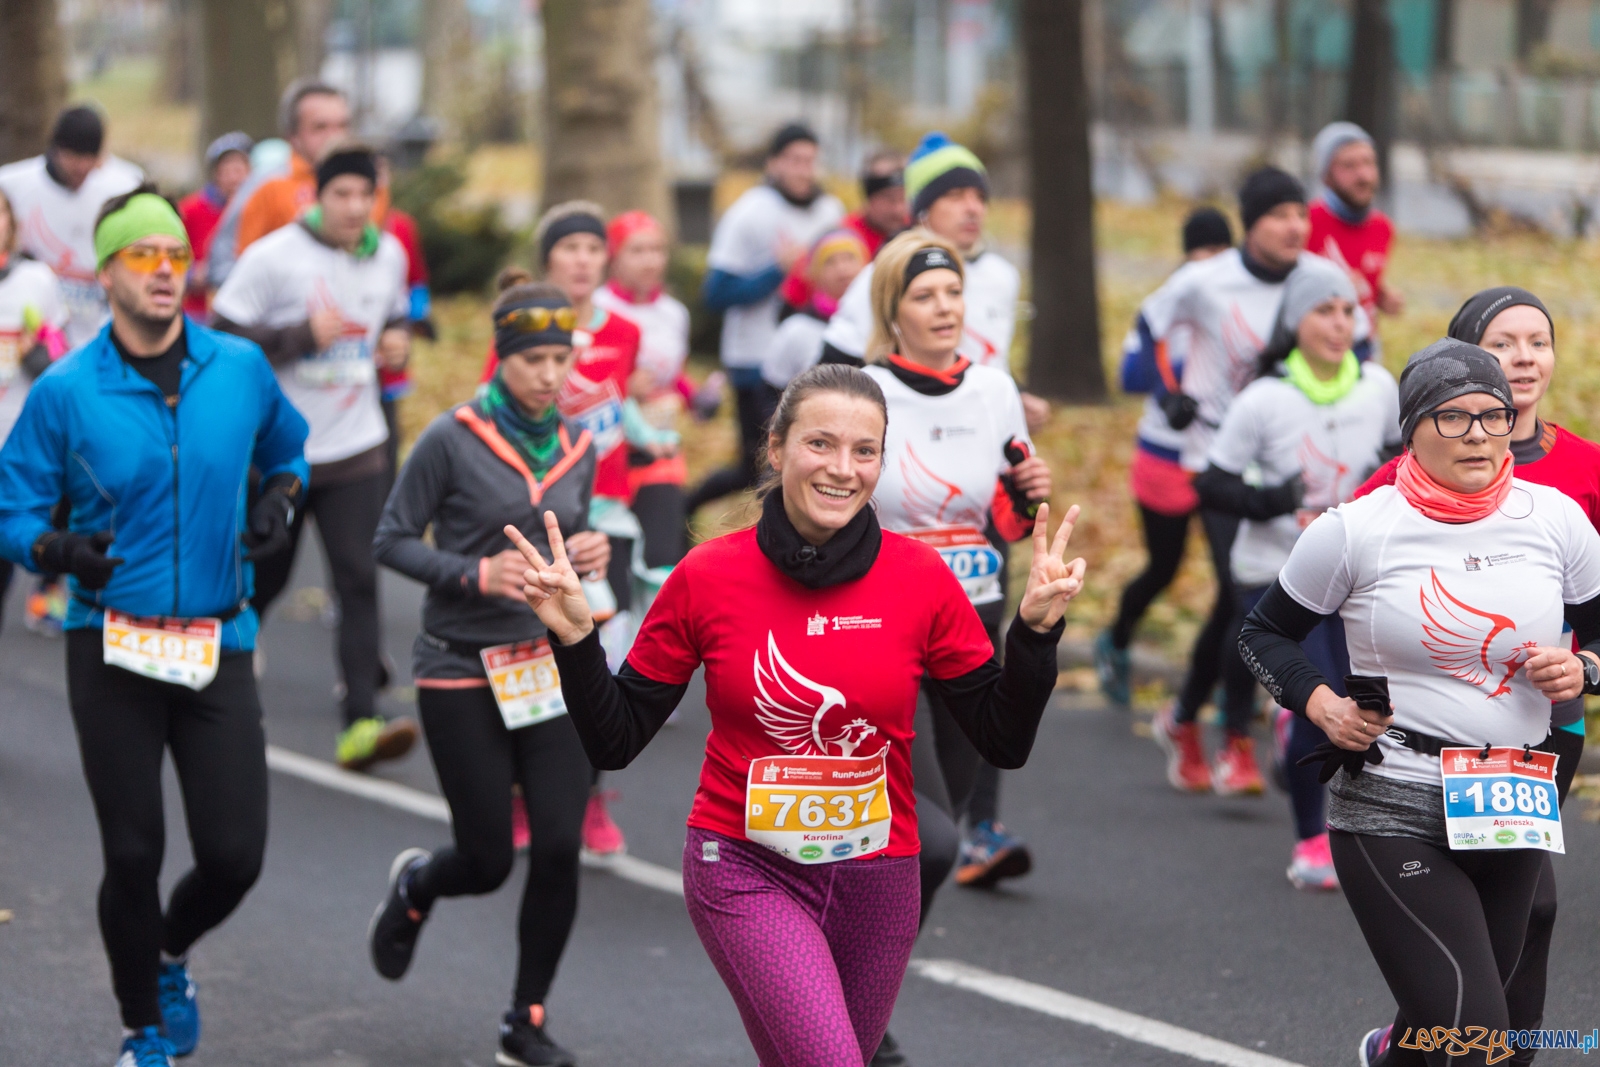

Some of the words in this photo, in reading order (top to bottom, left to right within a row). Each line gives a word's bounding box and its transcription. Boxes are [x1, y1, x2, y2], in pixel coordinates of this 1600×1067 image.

[1481, 294, 1512, 320] BROOKS
[832, 616, 841, 630] 1
[120, 631, 205, 664] 4495
[832, 764, 881, 779] RunPoland.org
[1513, 760, 1548, 774] RunPoland.org
[1449, 792, 1459, 803] E
[1465, 781, 1551, 816] 1888
[751, 804, 764, 816] D
[769, 788, 877, 828] 7637
[1493, 819, 1534, 828] Agnieszka
[1399, 866, 1430, 878] Kalenji
